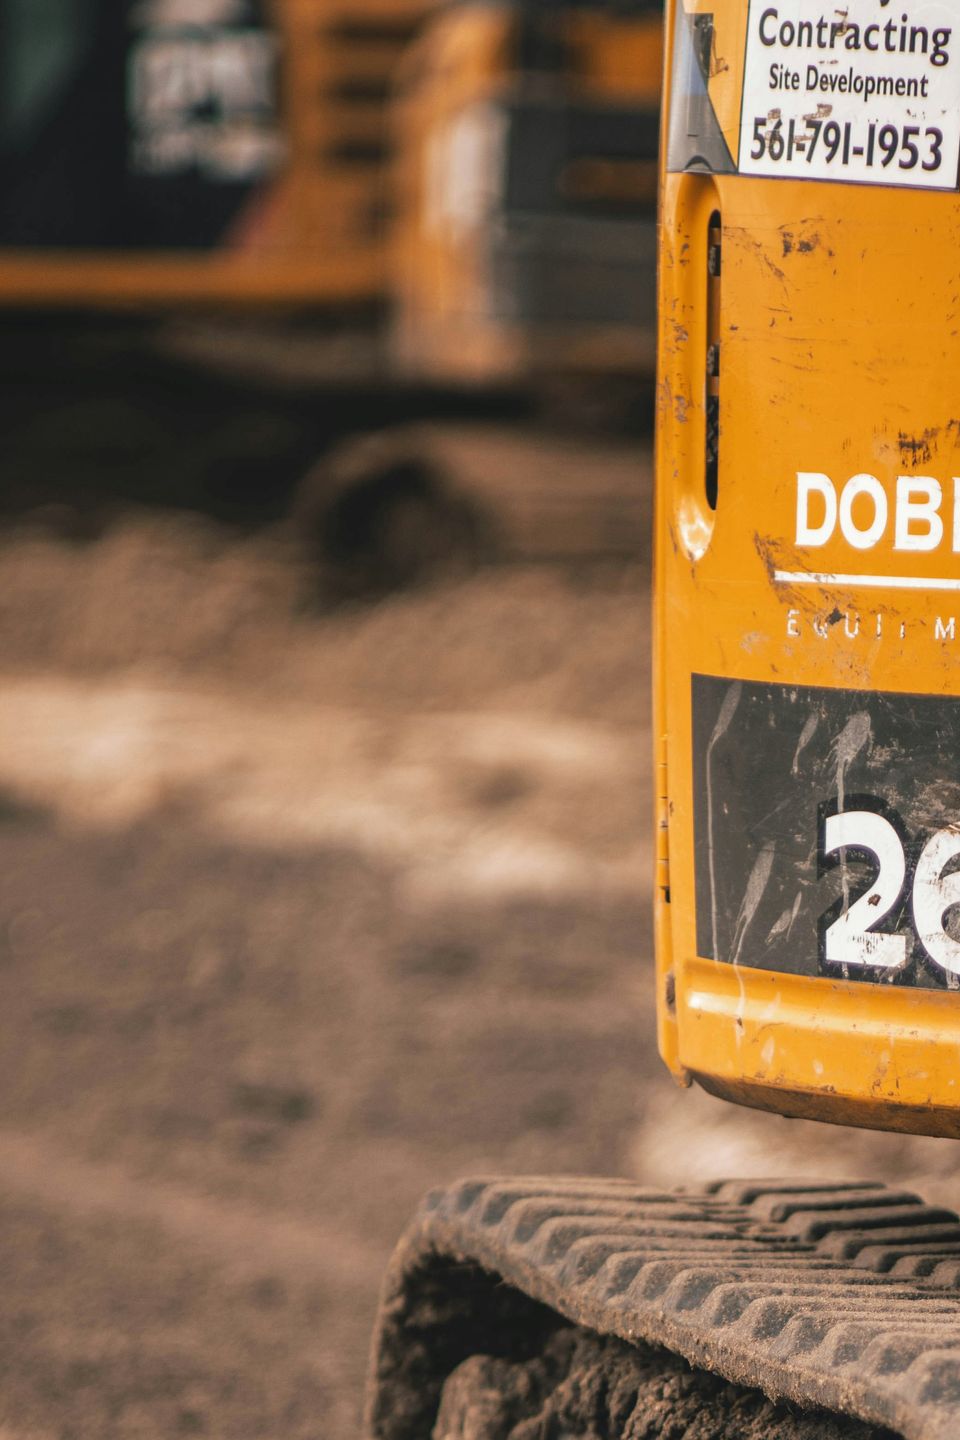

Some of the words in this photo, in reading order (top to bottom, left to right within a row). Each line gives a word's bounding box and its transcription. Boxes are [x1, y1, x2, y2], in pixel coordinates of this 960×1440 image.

[759, 8, 952, 67] Contracting
[769, 63, 801, 91] Site
[806, 65, 929, 102] Development
[751, 117, 944, 171] 561-791-1953
